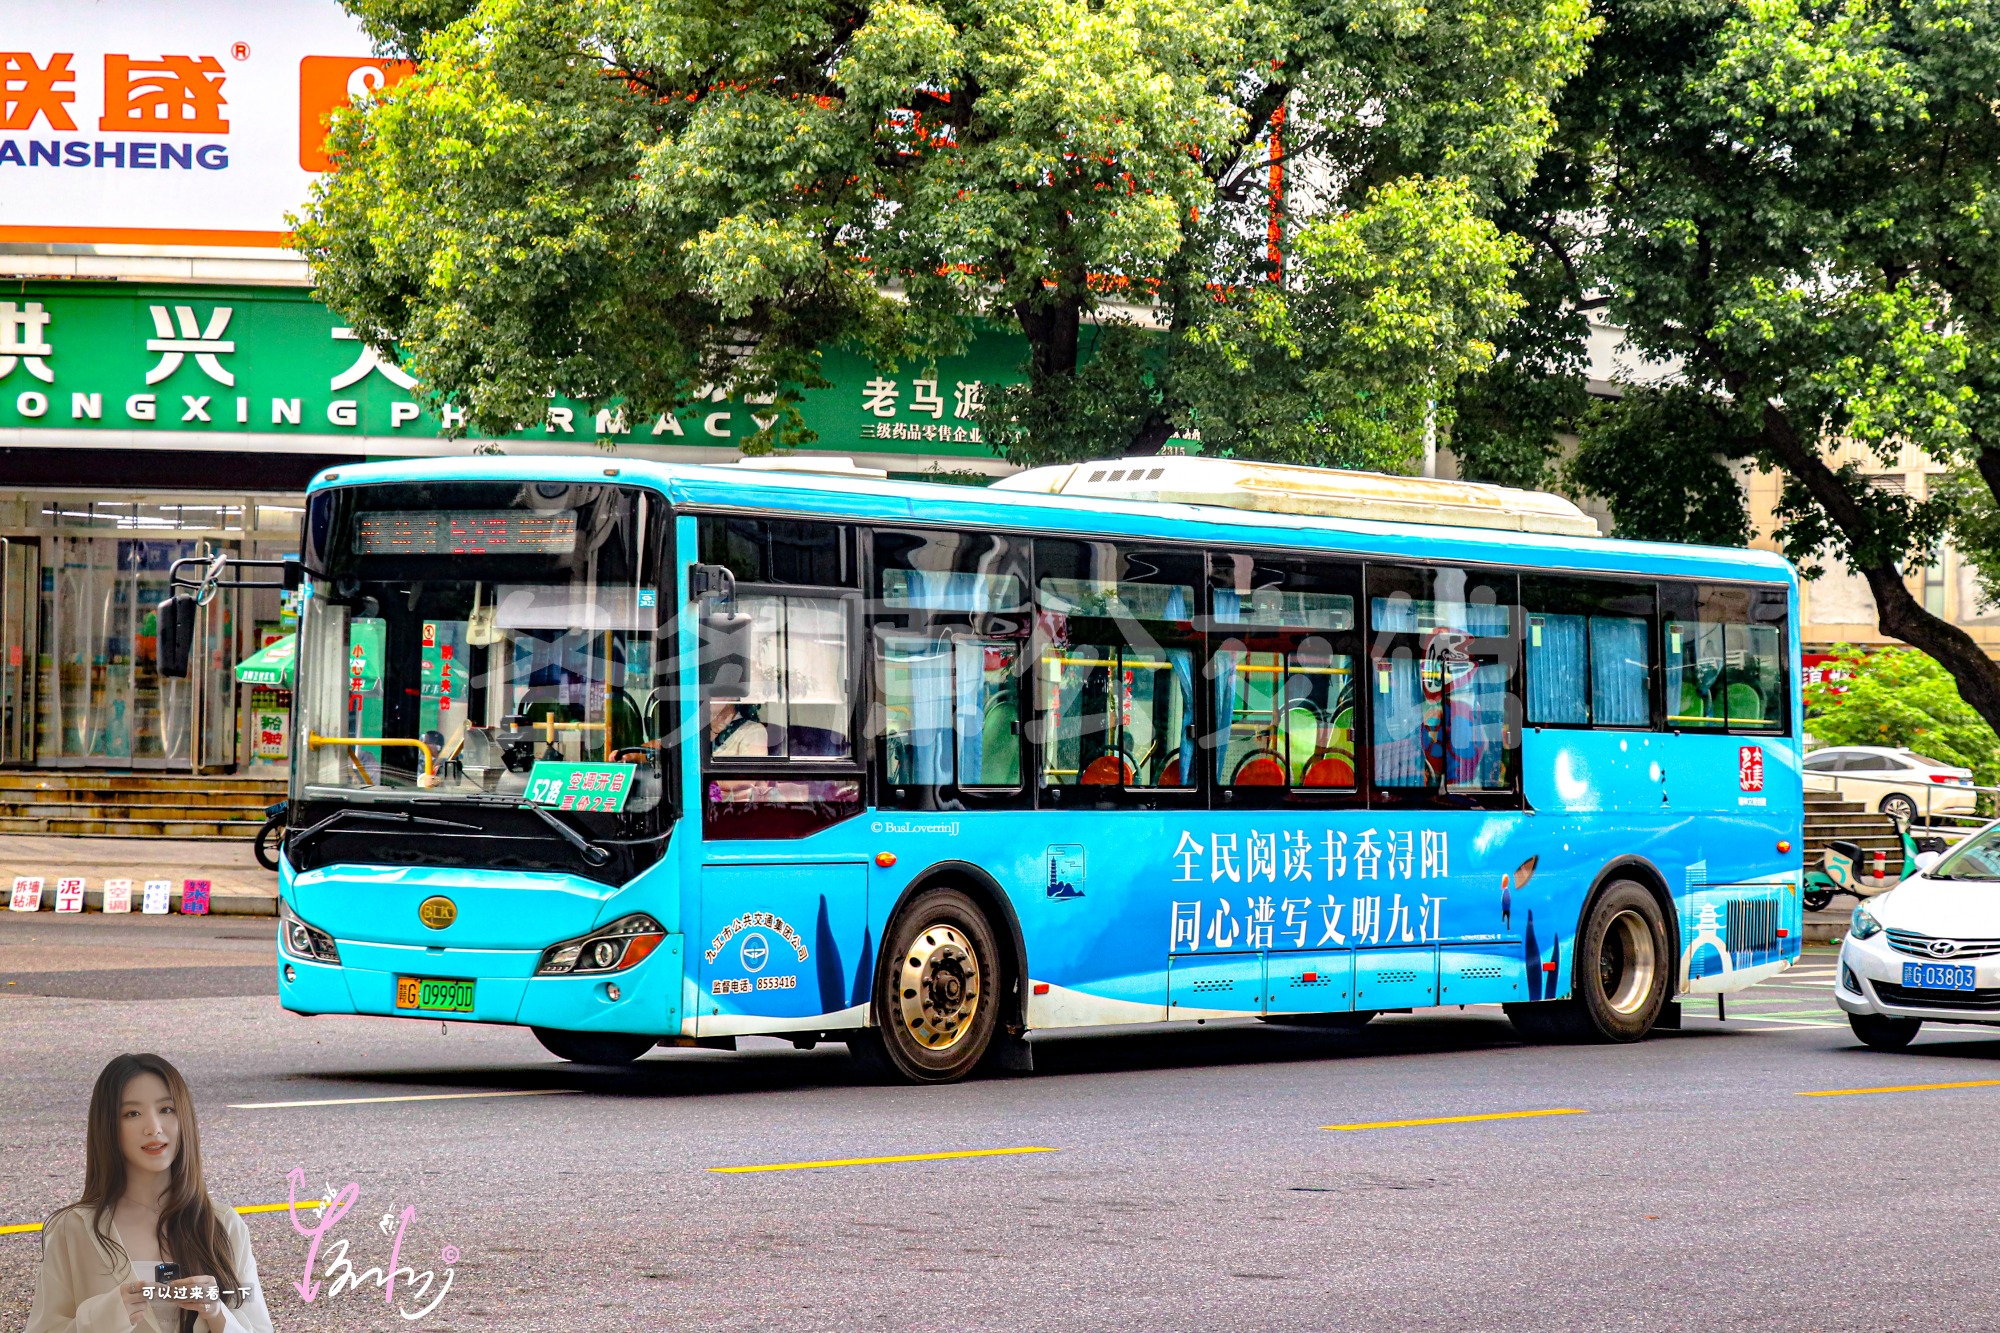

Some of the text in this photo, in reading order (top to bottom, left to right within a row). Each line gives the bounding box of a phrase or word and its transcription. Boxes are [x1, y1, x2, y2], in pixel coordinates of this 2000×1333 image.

[391, 401, 779, 437] PHRMACY
[531, 778, 563, 805] 52路
[567, 771, 626, 793] 空调开启
[1171, 827, 1449, 884] 全民阅读书香浔阳
[705, 911, 809, 965] 九江市公共交通集团公司
[1169, 892, 1448, 951] 同心谱写文明九江
